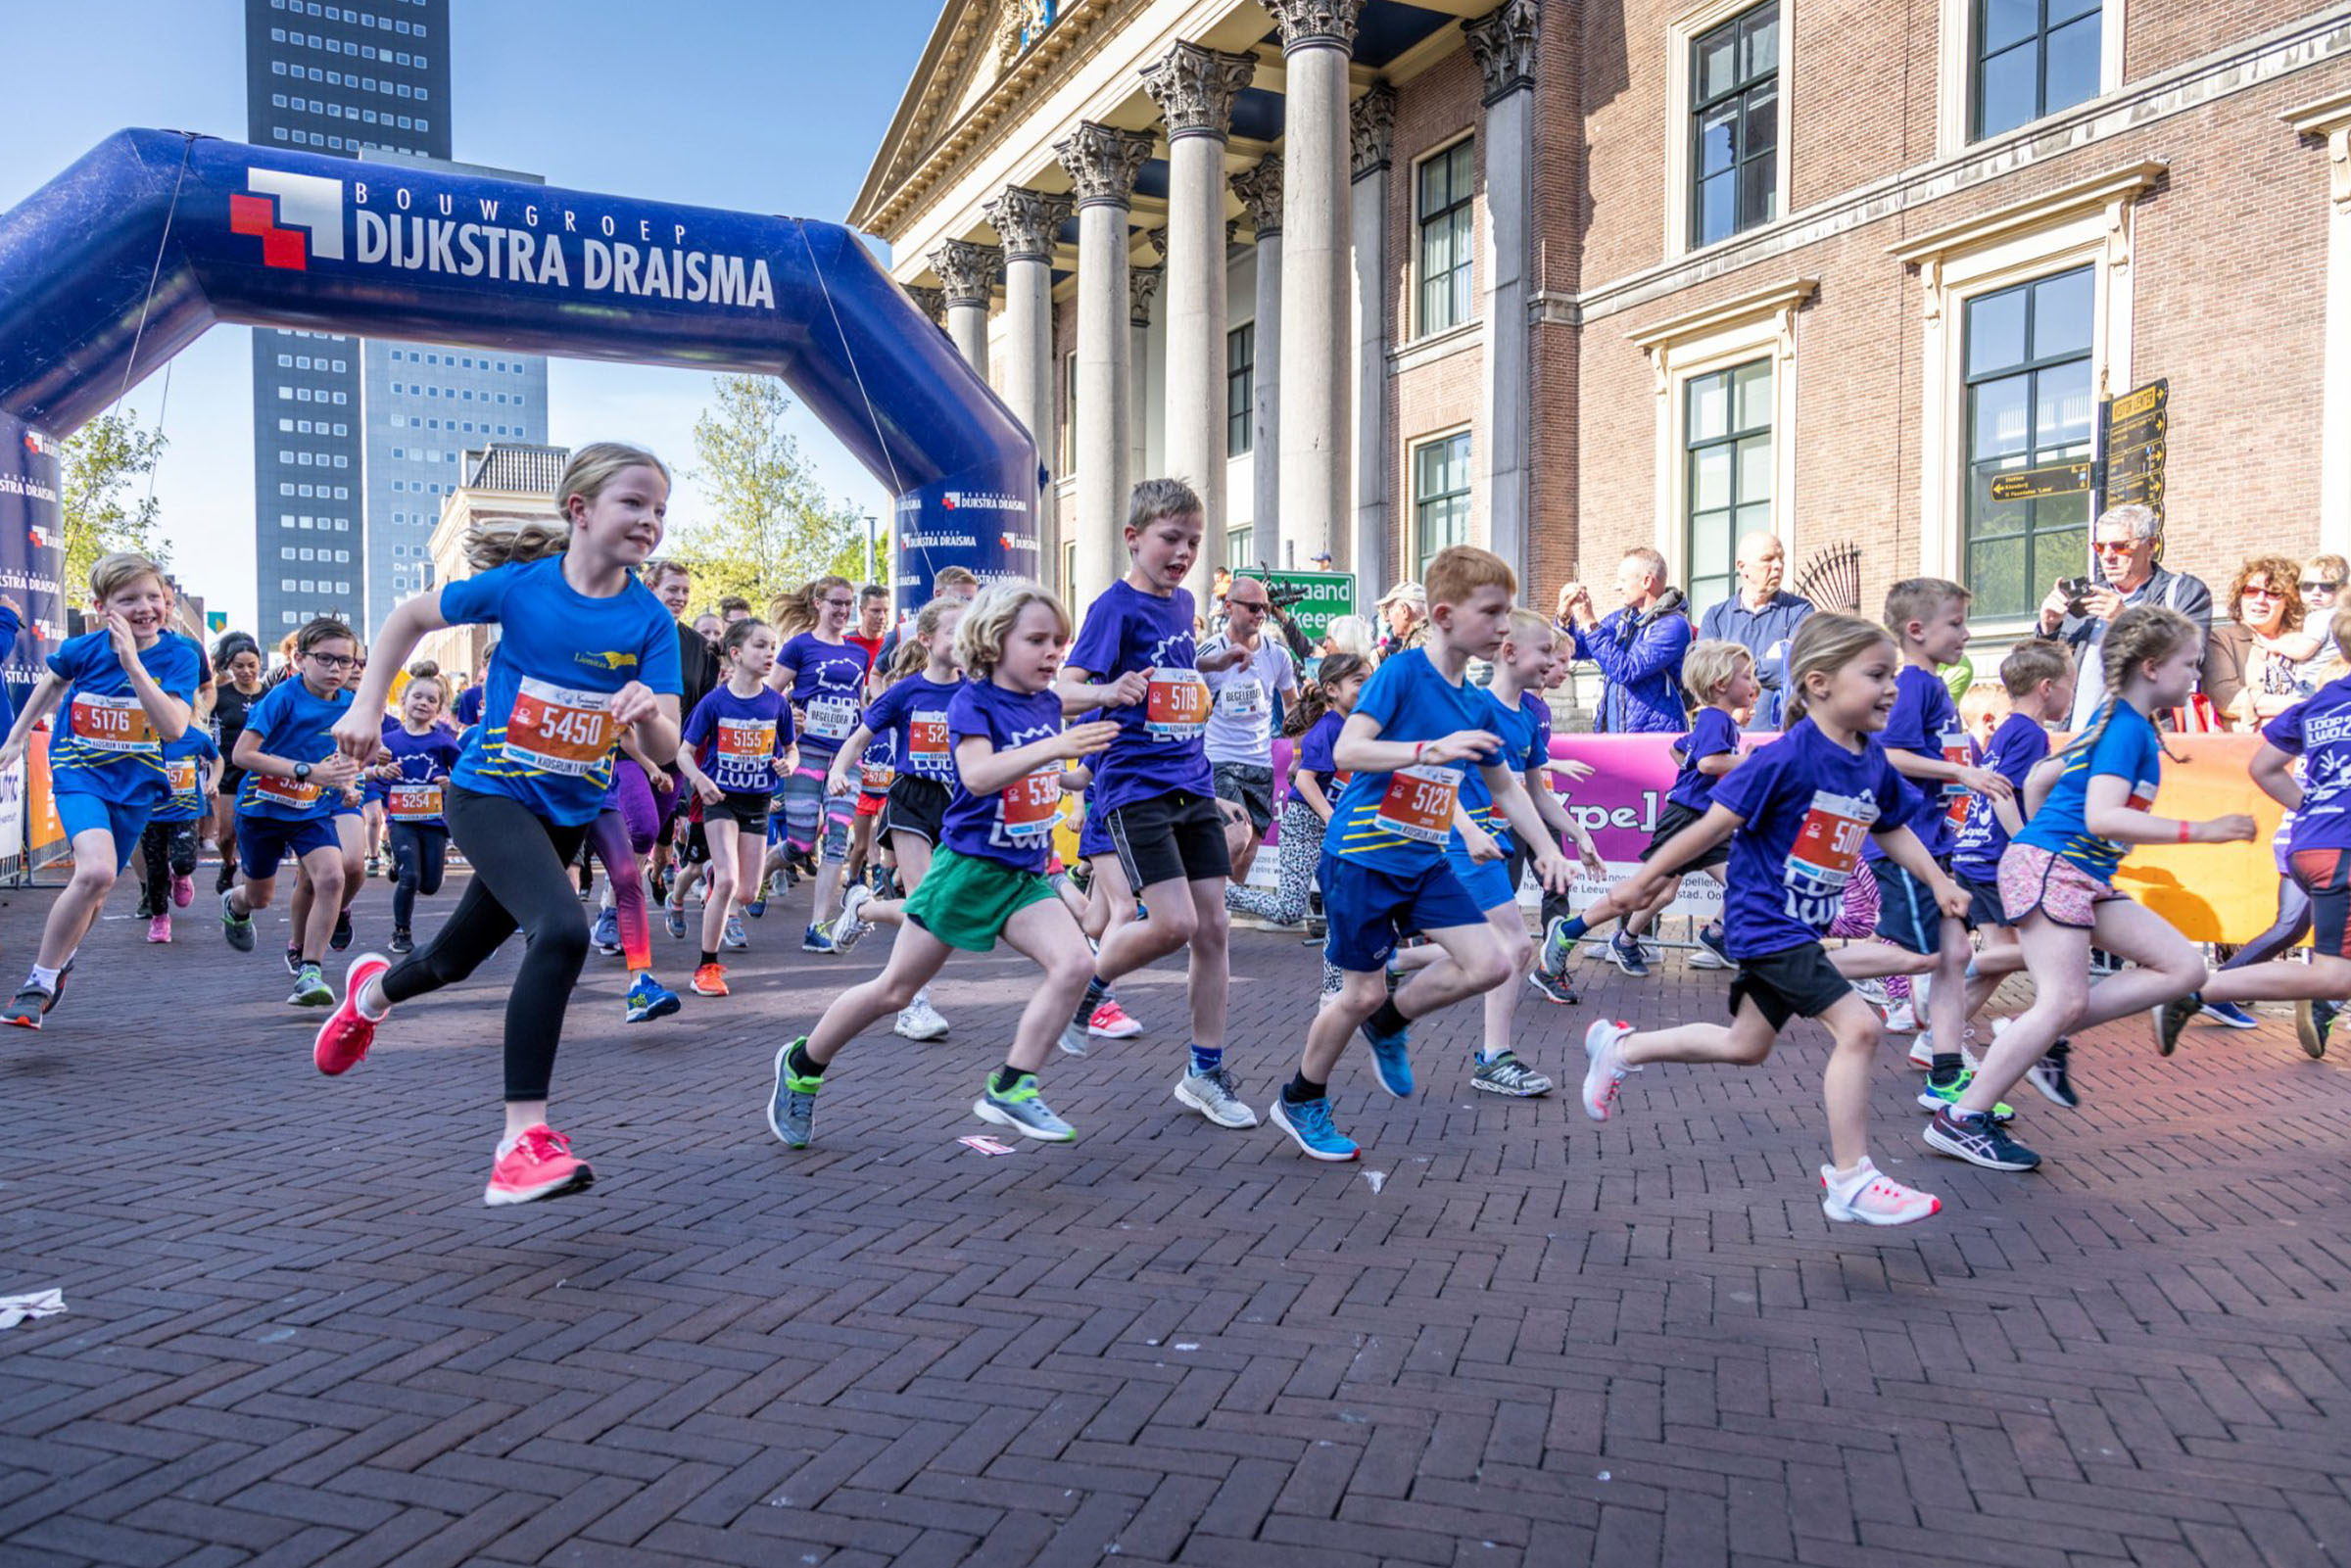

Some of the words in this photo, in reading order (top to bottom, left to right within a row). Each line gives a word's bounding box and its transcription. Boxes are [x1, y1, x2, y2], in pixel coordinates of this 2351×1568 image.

[356, 182, 686, 245] BOUWGROEP
[356, 209, 569, 287] DIJKSTRA
[583, 238, 775, 309] DRAISMA
[961, 498, 997, 509] DIJKSTRA
[997, 499, 1028, 512] DRAISMA
[939, 536, 978, 547] DRAISMA
[1286, 603, 1336, 630] keer
[1171, 685, 1197, 711] 5119
[91, 707, 129, 732] 5176
[540, 706, 603, 746] 5450
[2308, 716, 2342, 732] LOOP
[733, 730, 762, 748] 5155
[2309, 726, 2341, 744] LWD
[537, 755, 572, 773] KIDSRUN
[716, 769, 769, 788] LWD
[403, 793, 430, 808] 5254
[1412, 783, 1452, 816] 5123
